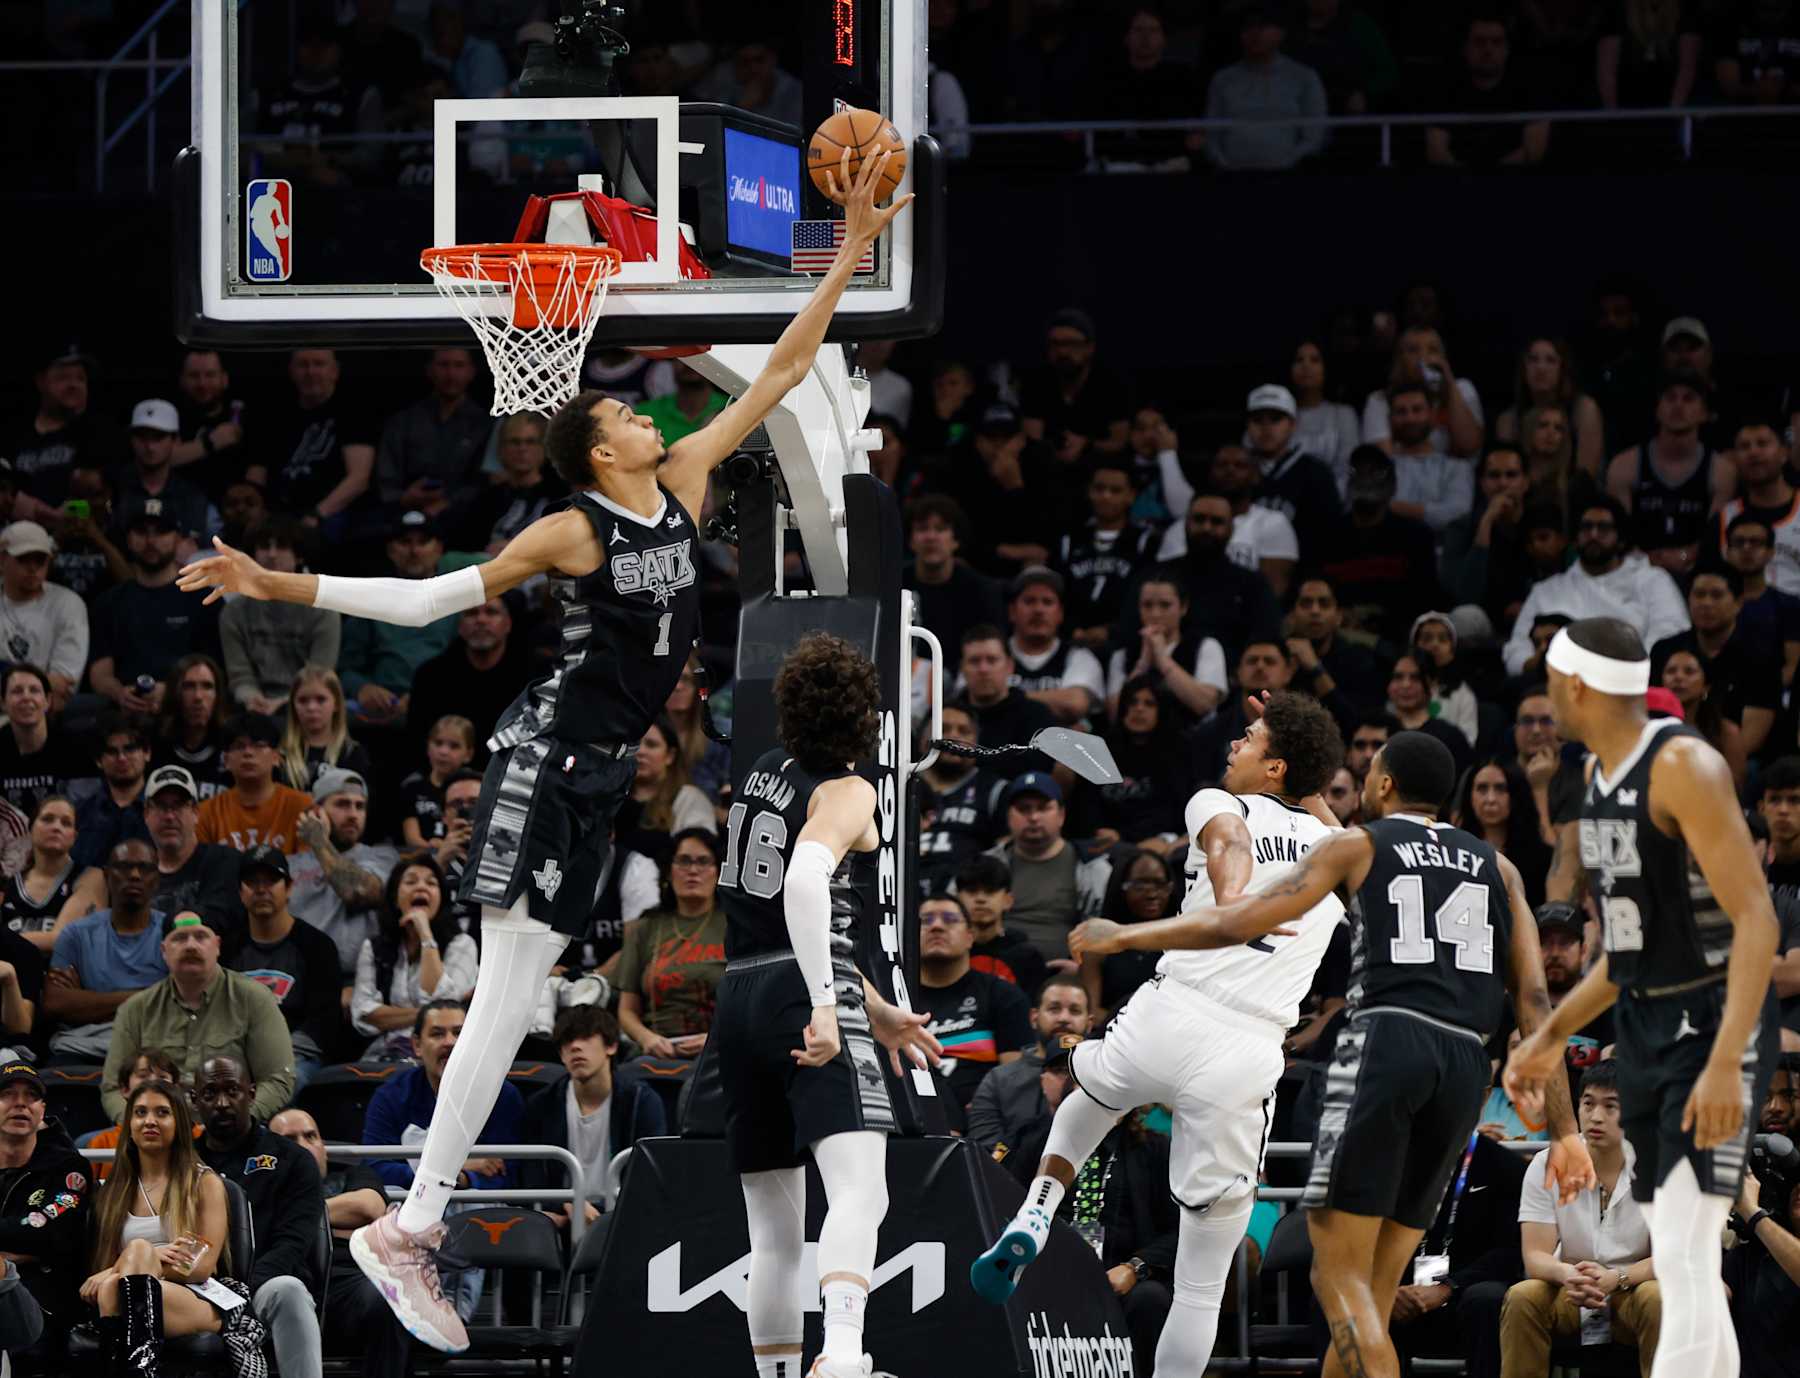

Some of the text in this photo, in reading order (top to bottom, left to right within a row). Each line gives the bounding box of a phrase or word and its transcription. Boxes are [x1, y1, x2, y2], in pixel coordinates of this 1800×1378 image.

[766, 187, 795, 214] ULTRA
[254, 258, 275, 275] NBA
[611, 538, 697, 596] SATX
[653, 612, 673, 656] 1
[743, 771, 796, 812] OSMAN
[718, 802, 788, 900] 16
[1393, 841, 1485, 878] WESLEY
[1387, 874, 1495, 975] 14
[1026, 1311, 1135, 1378] ticketmaster
